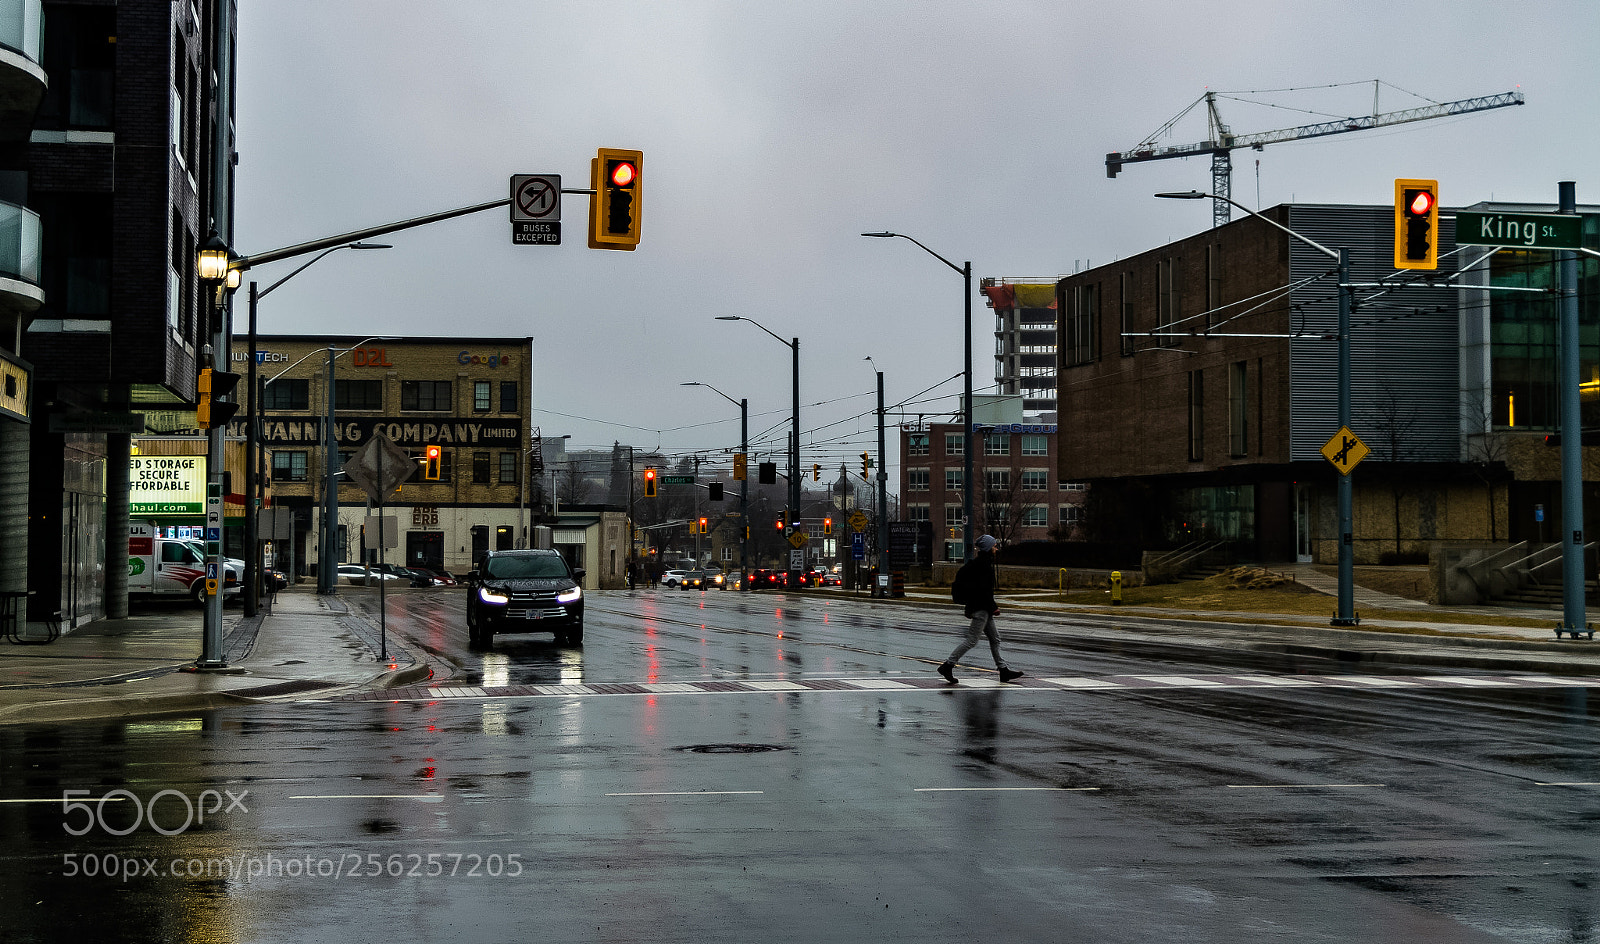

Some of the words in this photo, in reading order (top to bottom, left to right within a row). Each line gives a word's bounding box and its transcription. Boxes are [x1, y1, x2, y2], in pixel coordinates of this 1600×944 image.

[1481, 215, 1536, 245] King
[1542, 225, 1557, 237] St.
[516, 234, 558, 242] EXCEPTED
[354, 348, 392, 366] D2L
[458, 350, 510, 368] Google
[372, 422, 482, 443] COMPANY
[484, 428, 517, 438] LIMITED
[146, 460, 194, 468] STORAGE
[140, 470, 179, 479] SECURE
[414, 514, 438, 524] ERB
[854, 534, 862, 543] H
